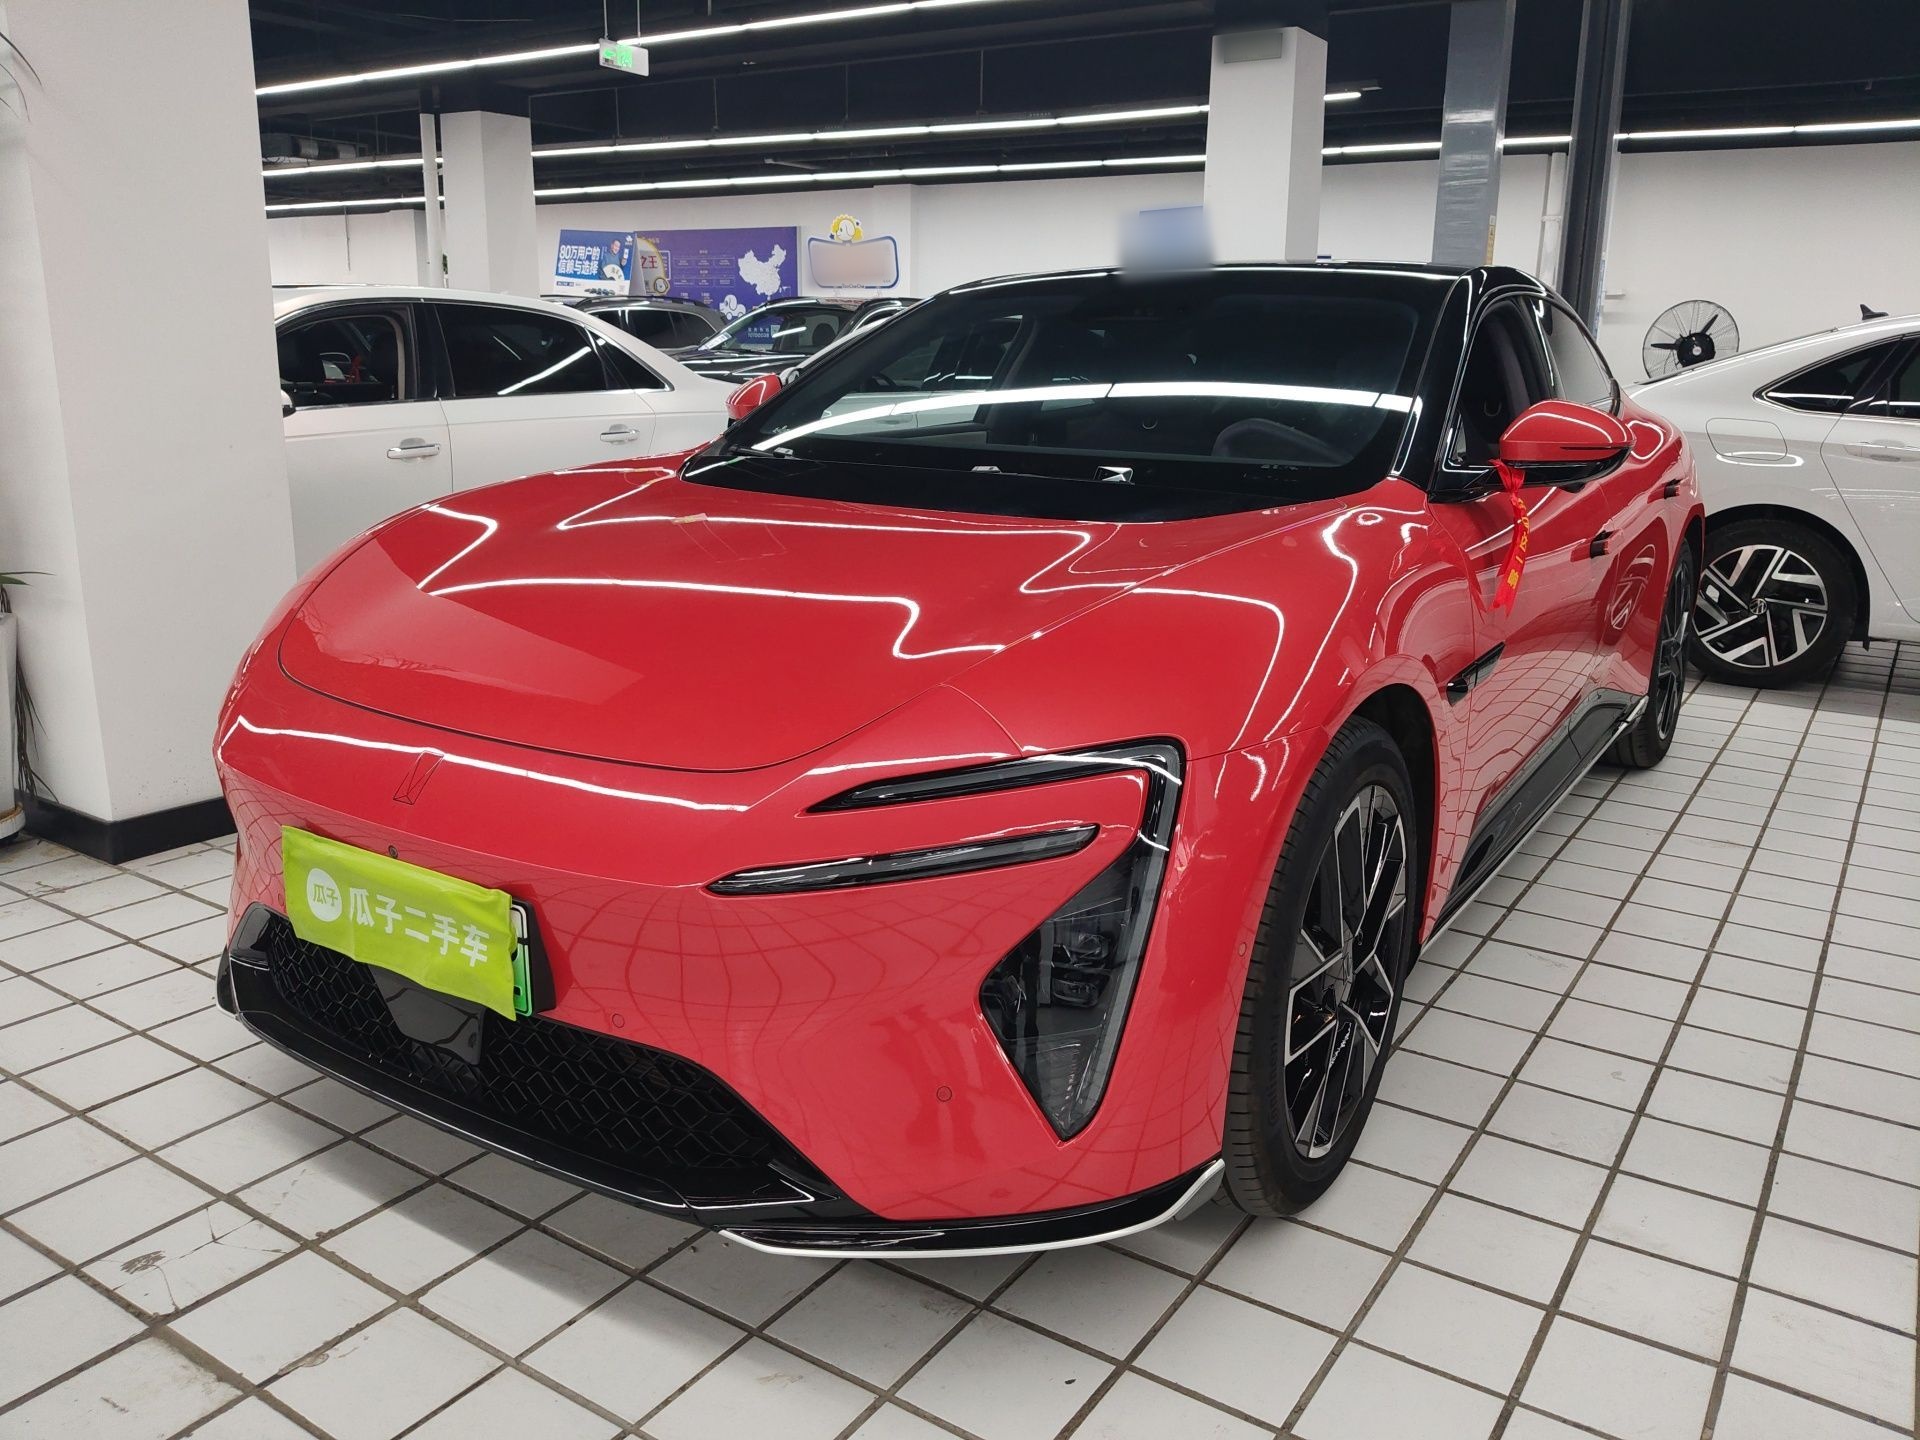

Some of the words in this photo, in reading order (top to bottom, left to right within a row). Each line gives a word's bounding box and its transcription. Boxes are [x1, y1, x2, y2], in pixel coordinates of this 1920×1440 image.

[559, 245, 600, 261] 80万用户的
[558, 259, 599, 276] 信赖与选择
[312, 884, 338, 907] 瓜子
[349, 887, 490, 967] 瓜子二手车
